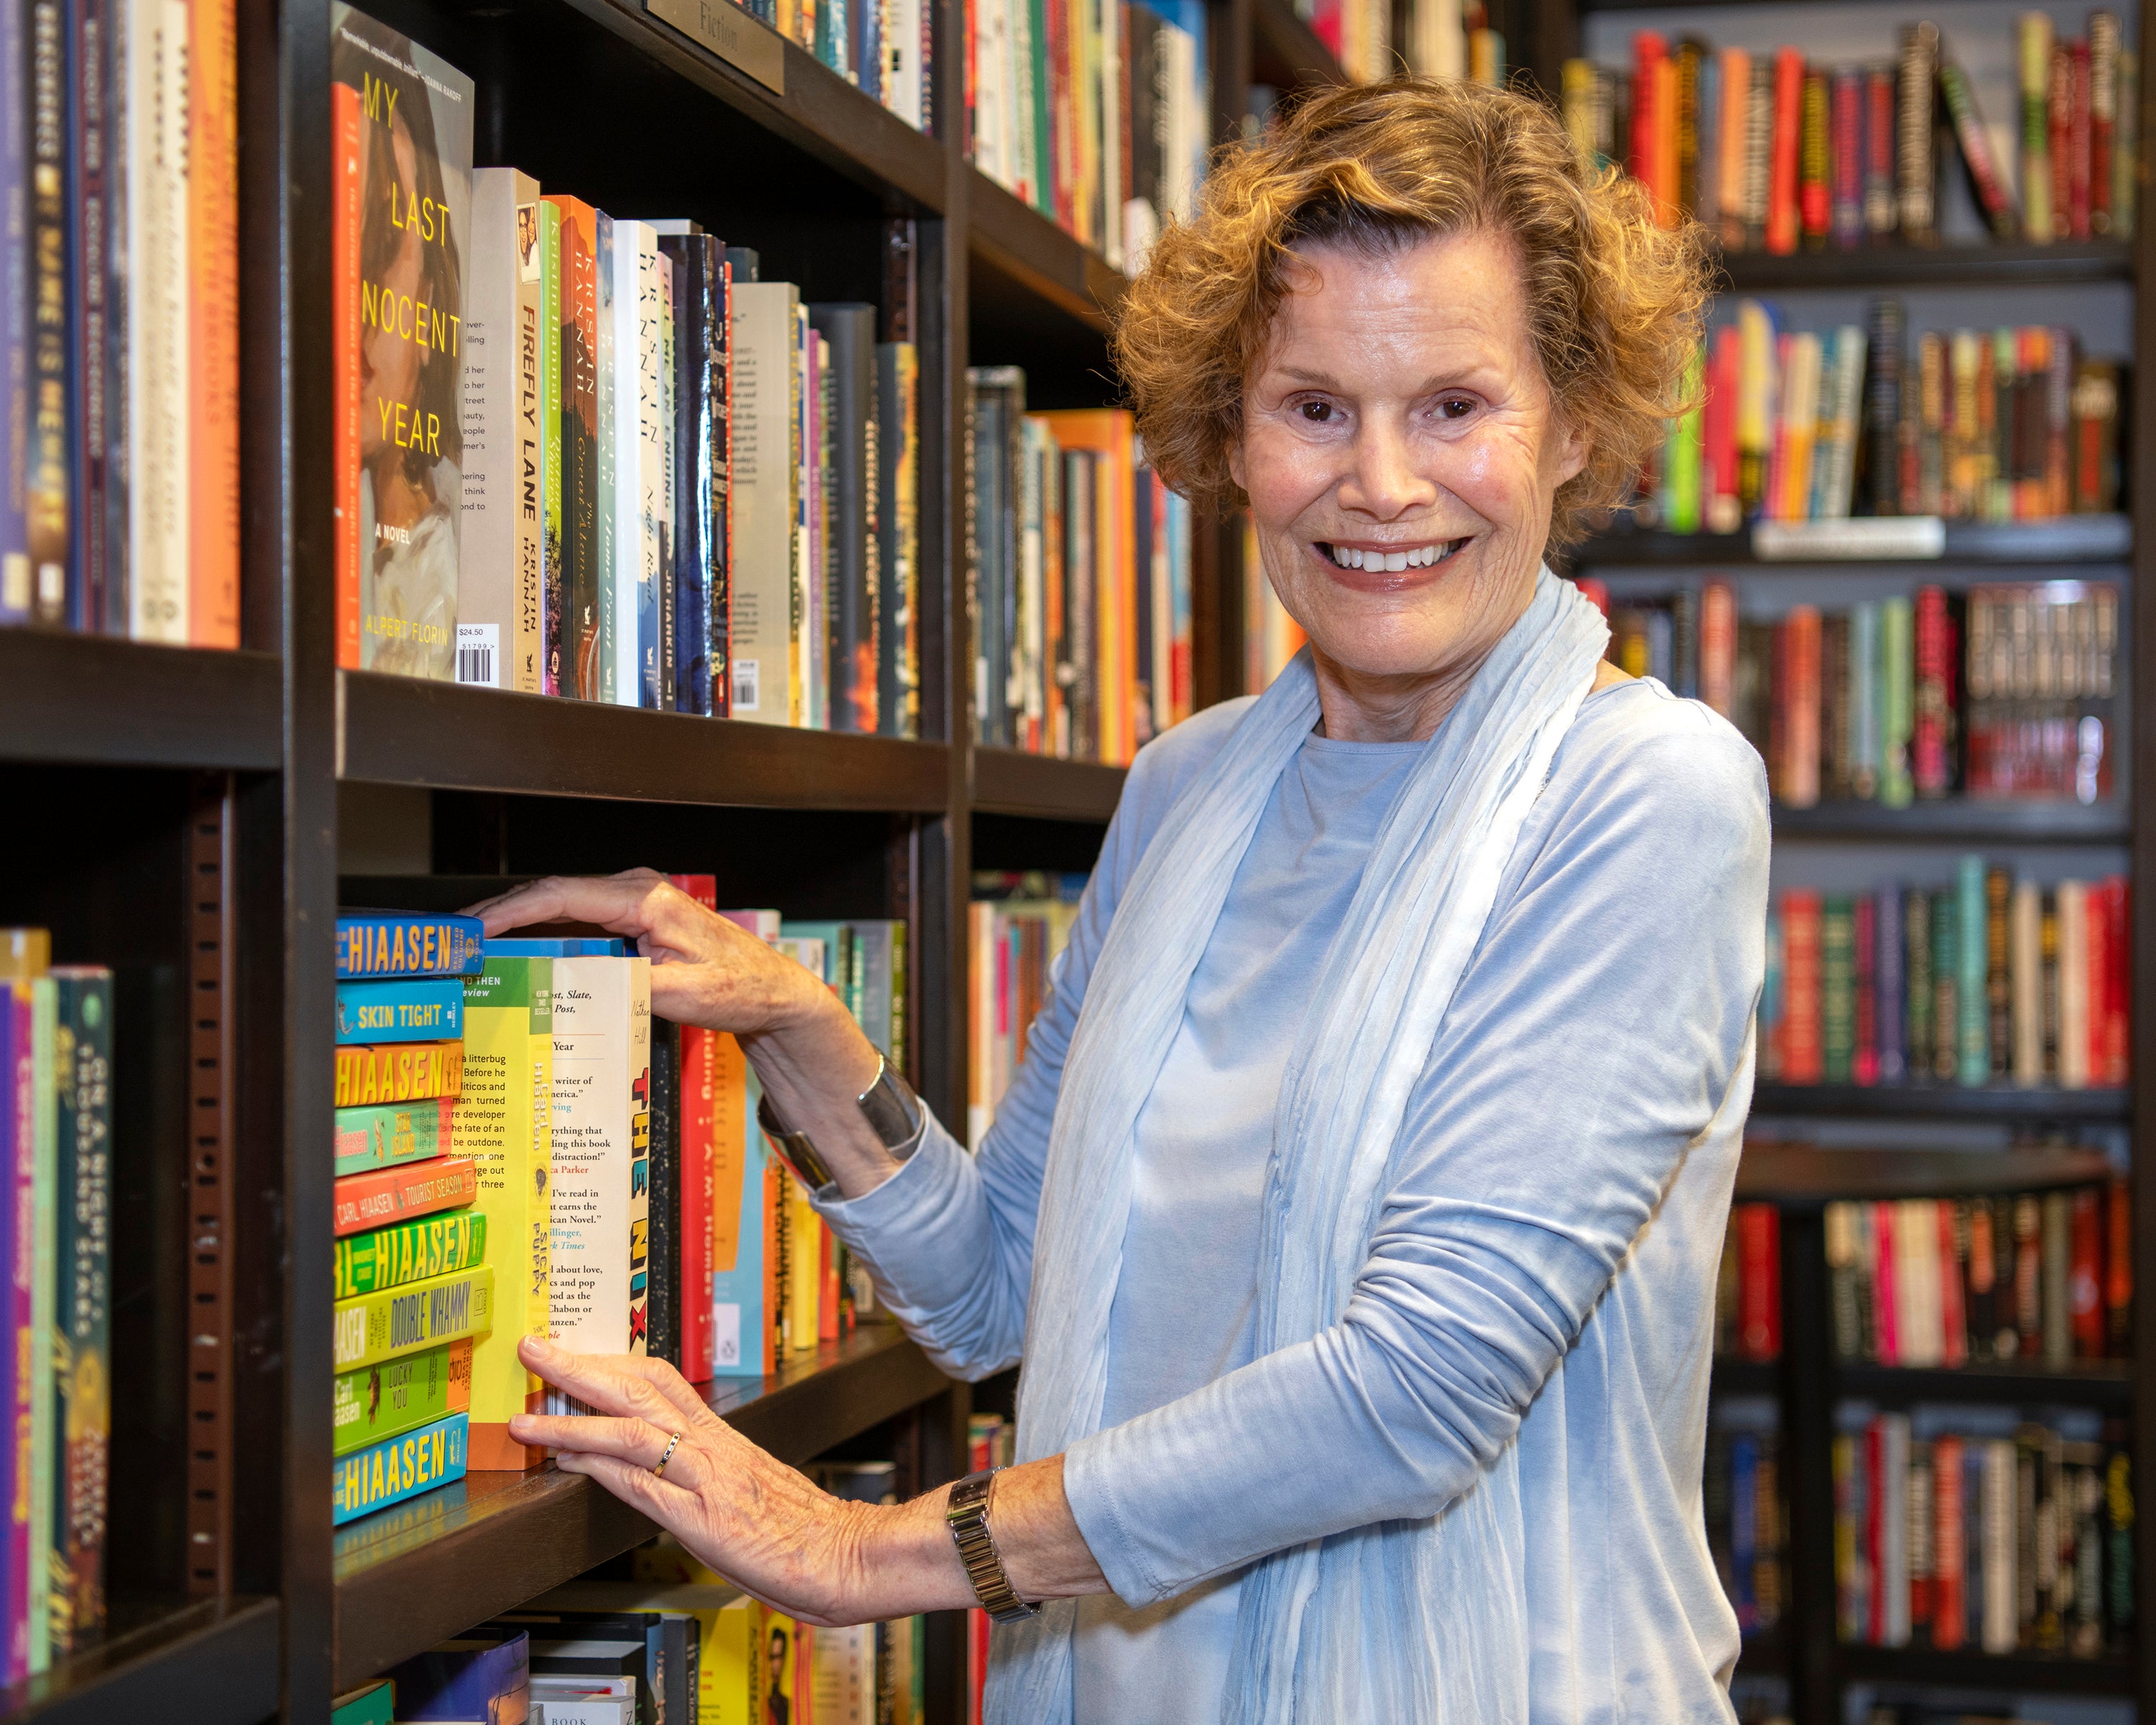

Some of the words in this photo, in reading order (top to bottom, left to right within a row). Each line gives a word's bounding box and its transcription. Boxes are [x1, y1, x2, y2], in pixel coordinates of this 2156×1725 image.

[700, 1, 737, 52] Fiction
[364, 71, 398, 128] MY
[443, 84, 462, 104] RAKOFF
[392, 181, 450, 247] LAST
[550, 220, 559, 293] Kristin
[361, 279, 461, 358] NOCENT
[576, 251, 584, 391] HANNAH
[586, 256, 594, 397] KRISTIN
[522, 304, 535, 428] FIREFLY
[551, 314, 560, 410] Hannah
[663, 338, 671, 372] ME
[664, 383, 671, 412] AN
[377, 396, 441, 457] YEAR
[464, 413, 485, 421] auty,
[463, 426, 485, 436] eople
[522, 438, 536, 522] LANE
[578, 436, 586, 505] Great
[374, 525, 382, 540] A
[383, 524, 410, 546] NOVEL
[646, 551, 655, 604] Road
[604, 585, 613, 648] Front
[365, 614, 407, 640] ALPERT
[412, 622, 448, 647] FLORIN
[459, 627, 483, 637] $24.50
[348, 924, 452, 974] HIAASEN
[476, 977, 500, 985] THEN
[566, 990, 592, 1000] Slate,
[358, 1006, 395, 1029] SKIN
[398, 1004, 441, 1028] TIGHT
[555, 1004, 576, 1013] Post,
[631, 999, 650, 1018] Nathan
[553, 1041, 574, 1051] Year
[634, 1026, 647, 1045] Hill
[469, 1054, 506, 1064] litterbug
[335, 1049, 443, 1108] HIAASEN
[464, 1068, 492, 1077] Before
[494, 1068, 505, 1077] he
[583, 1076, 593, 1085] of
[461, 1082, 487, 1090] liticos
[489, 1082, 505, 1090] and
[463, 1110, 505, 1121] developer
[533, 1062, 542, 1150] Hiaasen
[540, 1083, 549, 1127] Carl
[395, 1112, 411, 1135] STAR
[464, 1124, 481, 1133] fate
[483, 1124, 492, 1133] of
[631, 1067, 648, 1200] THE
[392, 1133, 415, 1156] ISLAND
[453, 1138, 464, 1146] be
[467, 1138, 505, 1146] outdone.
[571, 1139, 587, 1148] this
[589, 1139, 611, 1148] book
[449, 1151, 484, 1161] mention
[552, 1152, 605, 1161] distraction!”
[336, 1200, 360, 1226] CARL
[358, 1192, 394, 1220] HIAASEN
[405, 1181, 436, 1207] TOURIST
[437, 1174, 463, 1200] SEASON
[552, 1189, 567, 1197] I’ve
[569, 1189, 588, 1197] read
[590, 1189, 599, 1197] in
[550, 1215, 567, 1223] ican
[570, 1215, 602, 1223] Novel.”
[550, 1228, 581, 1238] illinger,
[561, 1241, 586, 1250] Times
[374, 1215, 471, 1290] HIAASEN
[704, 1215, 713, 1296] Homes
[556, 1265, 581, 1274] about
[583, 1265, 603, 1274] love,
[579, 1280, 595, 1289] pop
[629, 1218, 648, 1353] NIX
[390, 1291, 427, 1349] DOUBLE
[430, 1281, 471, 1338] WHAMMY
[549, 1304, 580, 1313] Chabon
[389, 1362, 413, 1389] LUCKY
[334, 1376, 353, 1406] Carl
[392, 1387, 407, 1411] YOU
[334, 1401, 361, 1427] aasen
[345, 1428, 446, 1512] HIAASEN
